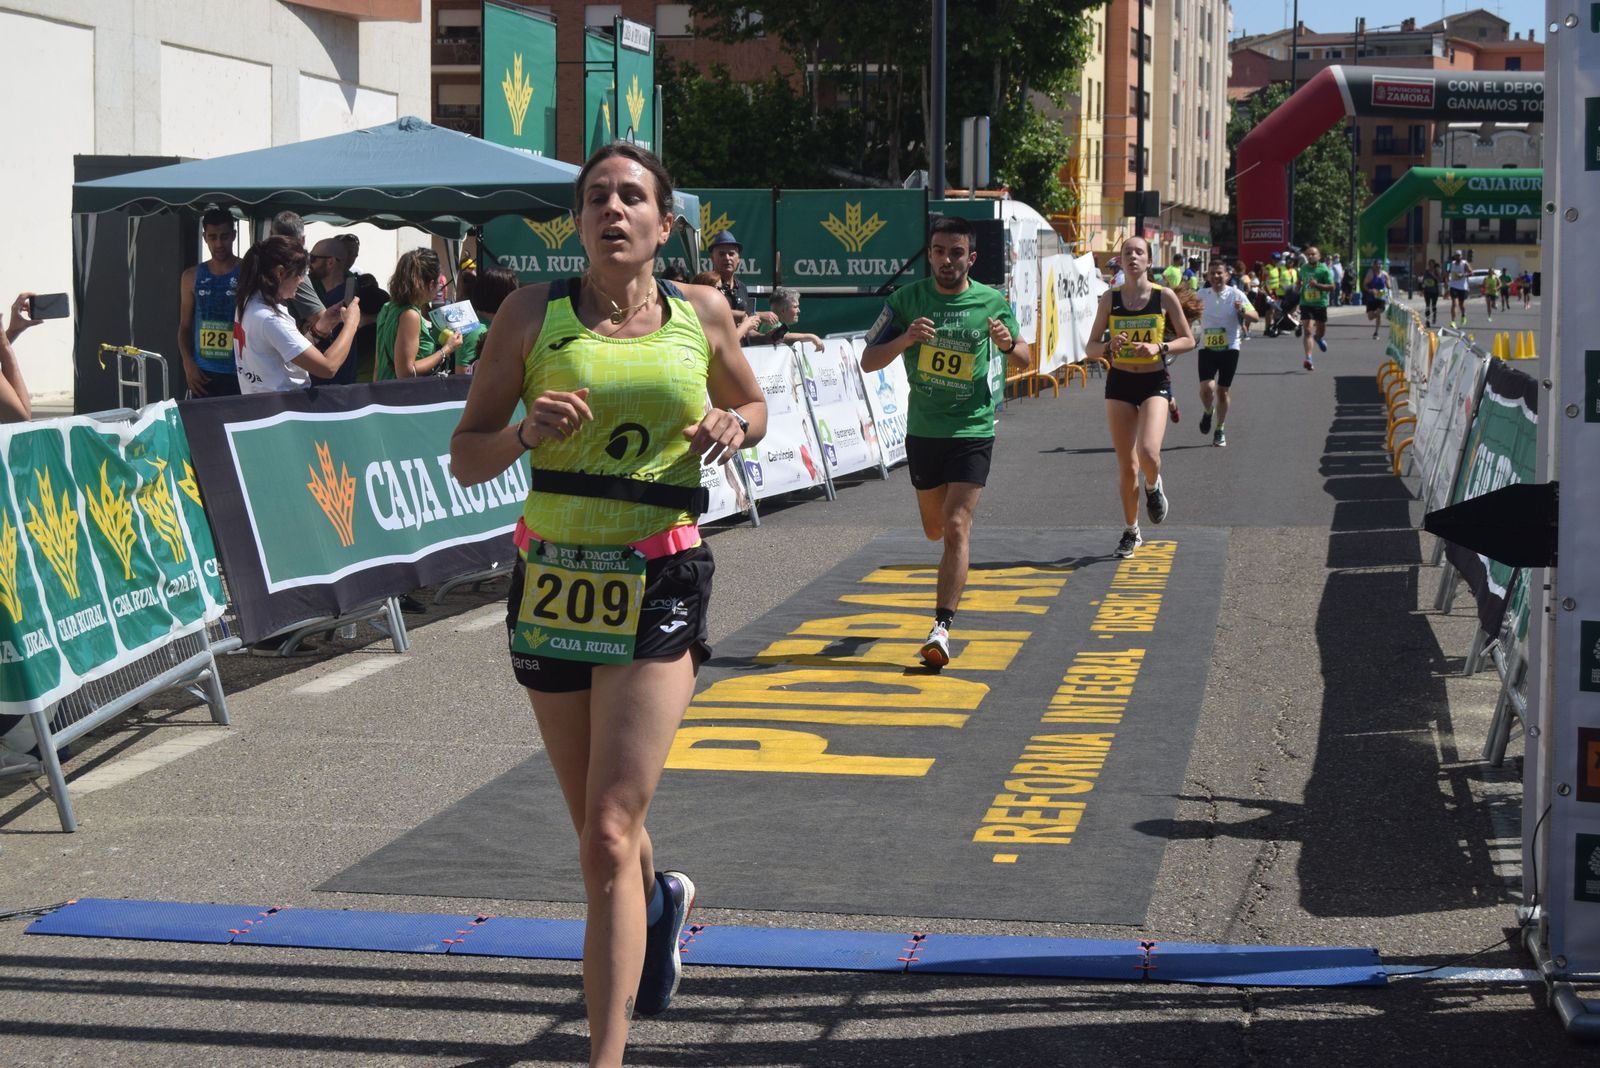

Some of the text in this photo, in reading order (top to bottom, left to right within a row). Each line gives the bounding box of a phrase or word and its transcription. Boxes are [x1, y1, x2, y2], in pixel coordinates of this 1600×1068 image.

[1447, 80, 1544, 94] CON EL DEPO
[1387, 94, 1430, 103] ZAMORA
[1447, 98, 1518, 111] GANAMOS
[1468, 177, 1506, 191] CAJA
[1462, 203, 1532, 215] SALIDA
[497, 255, 541, 272] CAJA
[793, 259, 915, 276] CAJA RURAL
[202, 331, 228, 347] 128
[931, 351, 962, 375] 69
[365, 458, 448, 531] CAJA
[561, 558, 629, 571] CAJA RURAL
[533, 573, 629, 627] 209
[550, 637, 628, 655] CAJA RURAL
[972, 648, 1147, 845] REFORMA INTEGRAL
